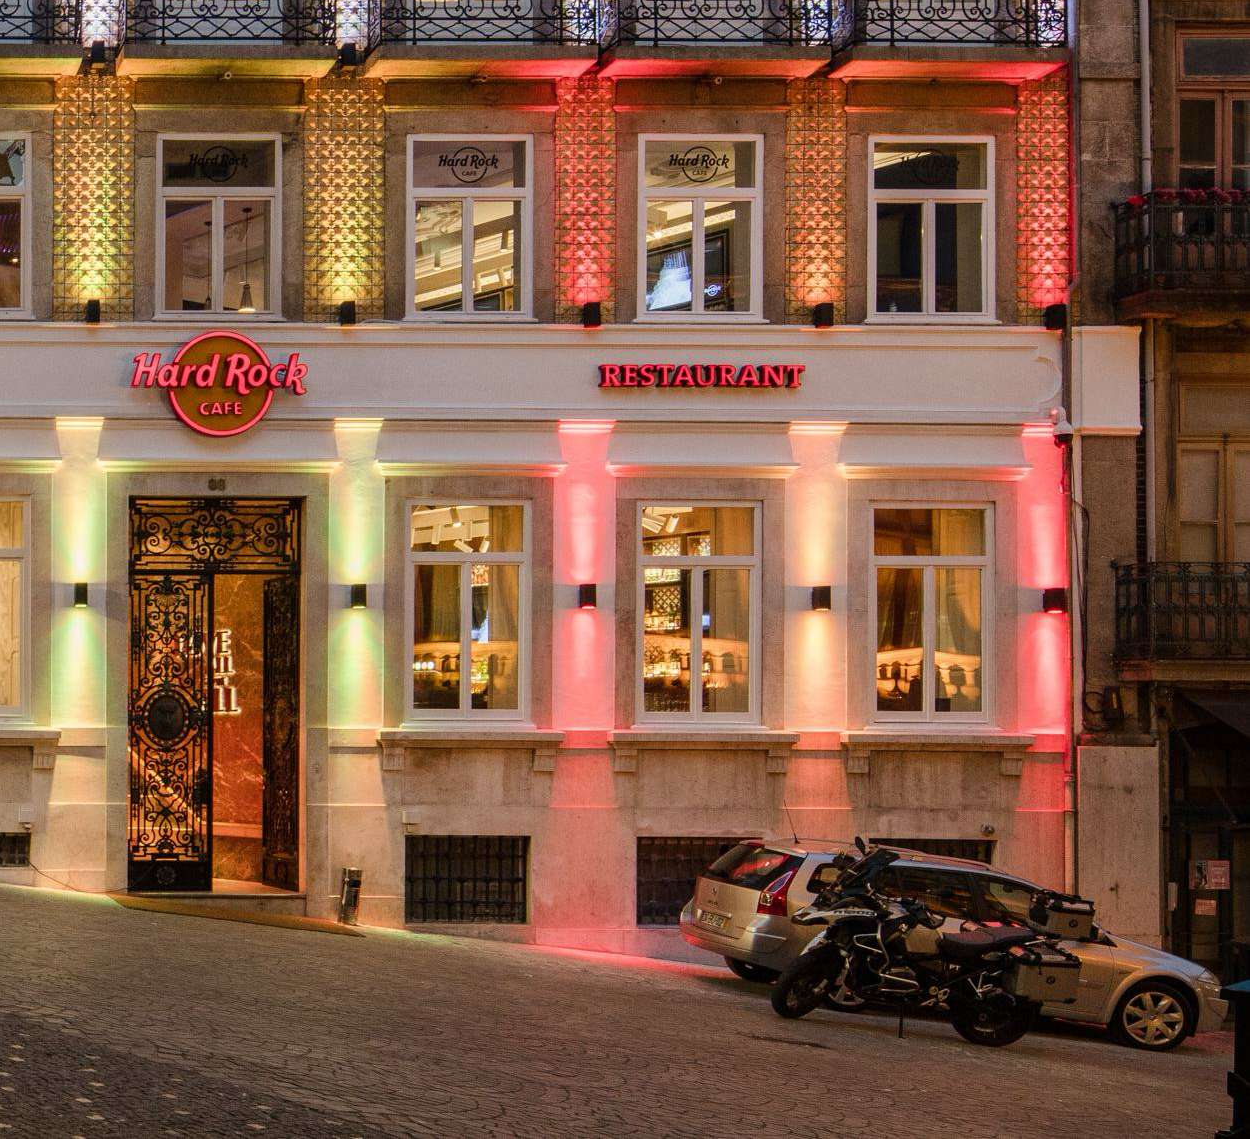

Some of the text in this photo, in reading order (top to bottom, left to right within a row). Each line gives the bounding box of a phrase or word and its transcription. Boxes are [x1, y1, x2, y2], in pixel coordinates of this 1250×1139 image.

[438, 154, 498, 169] Hard Rock
[669, 154, 730, 168] Hard Rock
[131, 353, 309, 395] Hard Rock
[599, 364, 805, 387] RESTAURANT
[200, 402, 242, 415] CAFE
